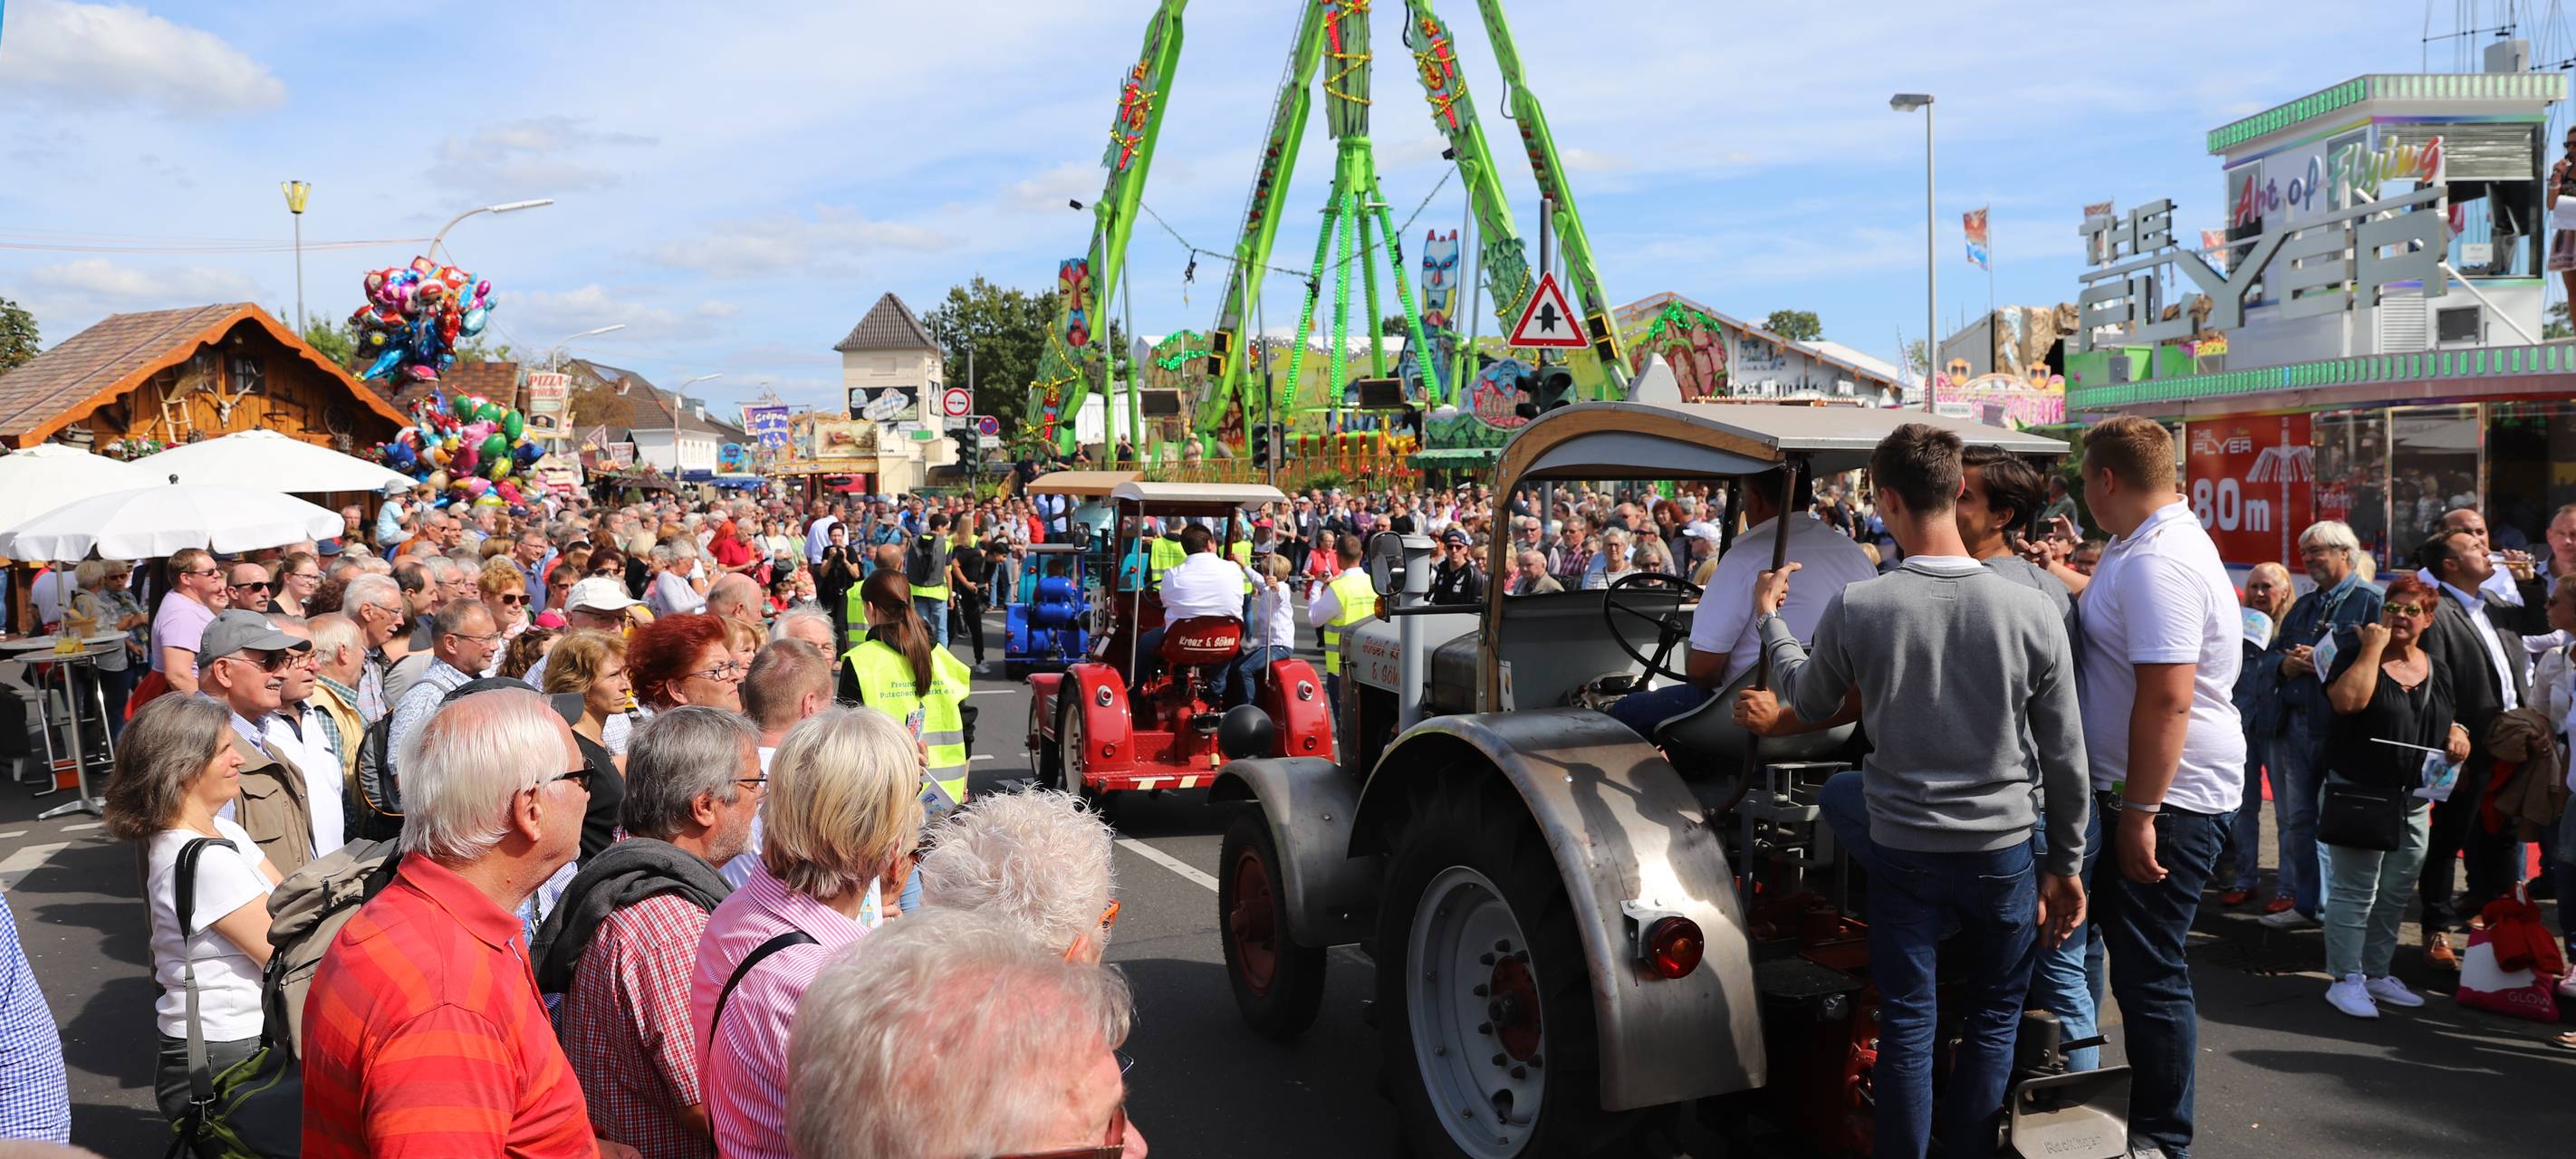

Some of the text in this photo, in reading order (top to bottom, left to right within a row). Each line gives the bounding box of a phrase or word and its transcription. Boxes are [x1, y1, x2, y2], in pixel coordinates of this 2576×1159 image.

[2234, 135, 2446, 229] Art of Flying
[2079, 197, 2175, 266] THE
[2078, 186, 2449, 353] FLYER
[2192, 428, 2212, 439] THE
[2192, 436, 2253, 456] FLYER
[1092, 608, 1104, 627] 19
[1178, 636, 1204, 647] Kreuz
[1206, 637, 1212, 647] &
[2506, 991, 2552, 1007] GLOW
